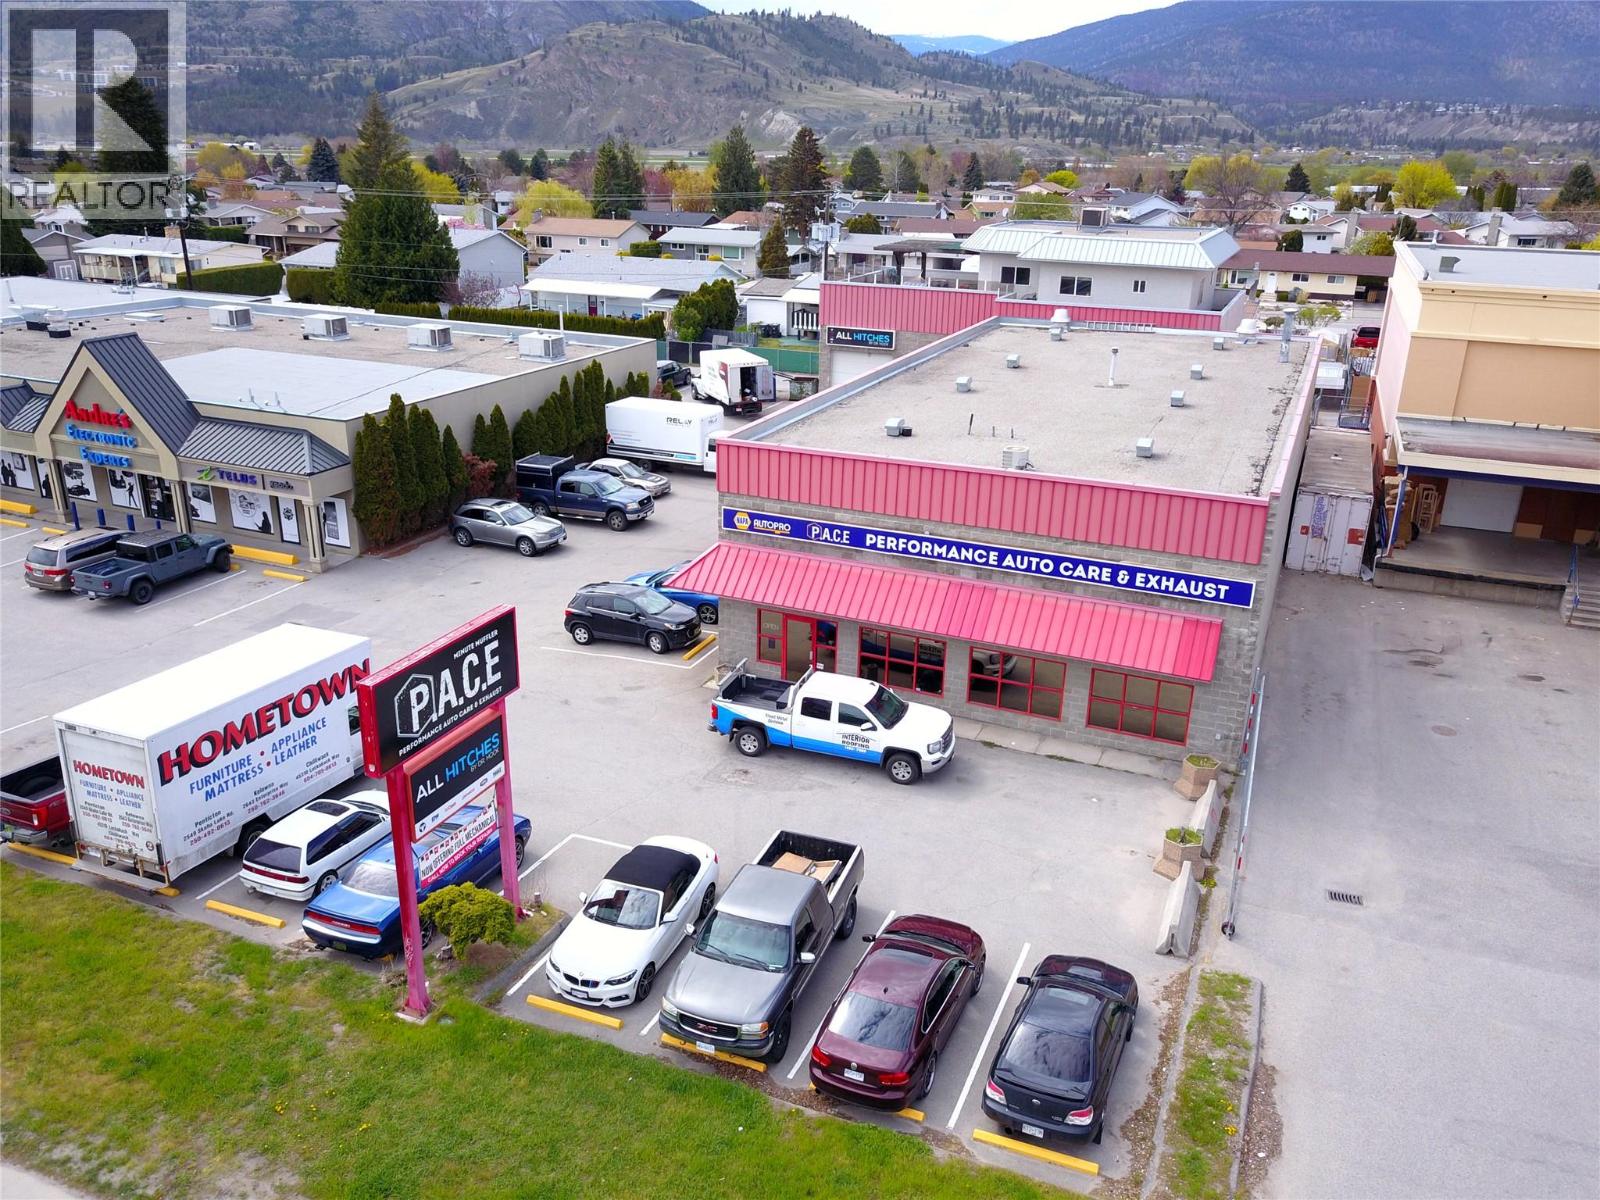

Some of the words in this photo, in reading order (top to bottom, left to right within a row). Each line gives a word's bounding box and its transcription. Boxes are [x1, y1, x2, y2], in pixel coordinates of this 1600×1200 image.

[836, 331, 852, 340] ALL
[853, 333, 890, 343] HITCHES
[216, 469, 257, 485] TELUS
[753, 519, 791, 532] AUTOPRO
[865, 533, 999, 566] PERFORMANCE
[1002, 553, 1055, 573] AUTO
[1059, 562, 1112, 582] CARE
[1117, 570, 1130, 584] &
[1135, 572, 1230, 600] EXHAUST
[453, 643, 475, 660] MINUTE
[475, 629, 498, 648] MUFFLER
[157, 658, 370, 787] HOMETOWN
[398, 724, 443, 757] PERFORMANCE
[443, 714, 459, 728] AUTO
[458, 704, 474, 717] CARE
[479, 686, 503, 705] EXHAUST
[841, 740, 870, 749] ROOFING
[842, 734, 870, 744] INTERIOR
[189, 755, 253, 794] FURNITURE
[271, 717, 327, 755] APPLIANCE
[204, 764, 264, 802] MATTRESS
[274, 735, 318, 766] LEATHER
[416, 774, 444, 803] ALL
[445, 733, 500, 782] HITCHES
[72, 760, 145, 789] HOMETOWN
[253, 782, 275, 796] Kelowna
[194, 810, 221, 828] Penticton
[421, 866, 434, 878] NOW
[432, 845, 454, 867] OFFERING
[454, 840, 465, 851] FULL
[465, 814, 495, 840] MECHANICAL
[427, 872, 439, 883] CALL
[438, 864, 449, 874] NOW
[454, 849, 466, 862] BOOK
[465, 841, 477, 852] YOUR
